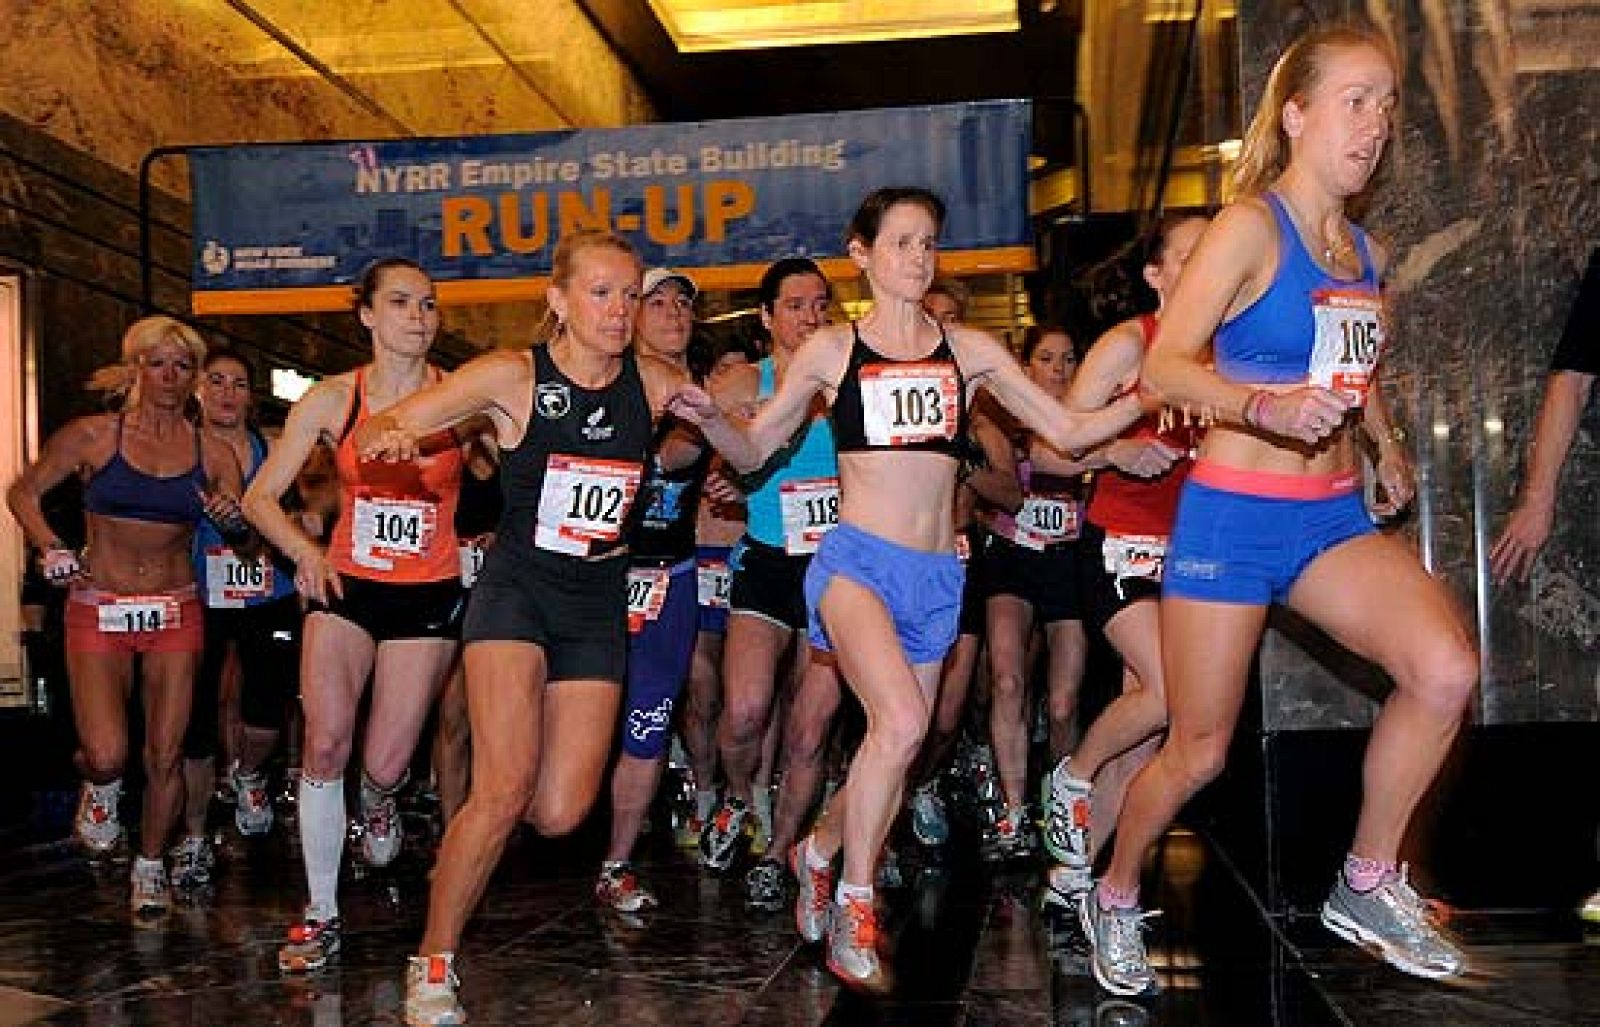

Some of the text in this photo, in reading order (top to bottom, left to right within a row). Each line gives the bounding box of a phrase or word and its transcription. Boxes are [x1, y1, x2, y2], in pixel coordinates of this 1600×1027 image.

[355, 138, 846, 194] NYRR Empire State Building
[440, 180, 757, 258] RUN-UP
[1338, 320, 1376, 366] 105
[889, 386, 944, 428] 103
[567, 483, 623, 523] 102
[1032, 505, 1063, 530] 110
[374, 512, 421, 545] 104
[225, 562, 262, 586] 106
[124, 610, 162, 633] 114
